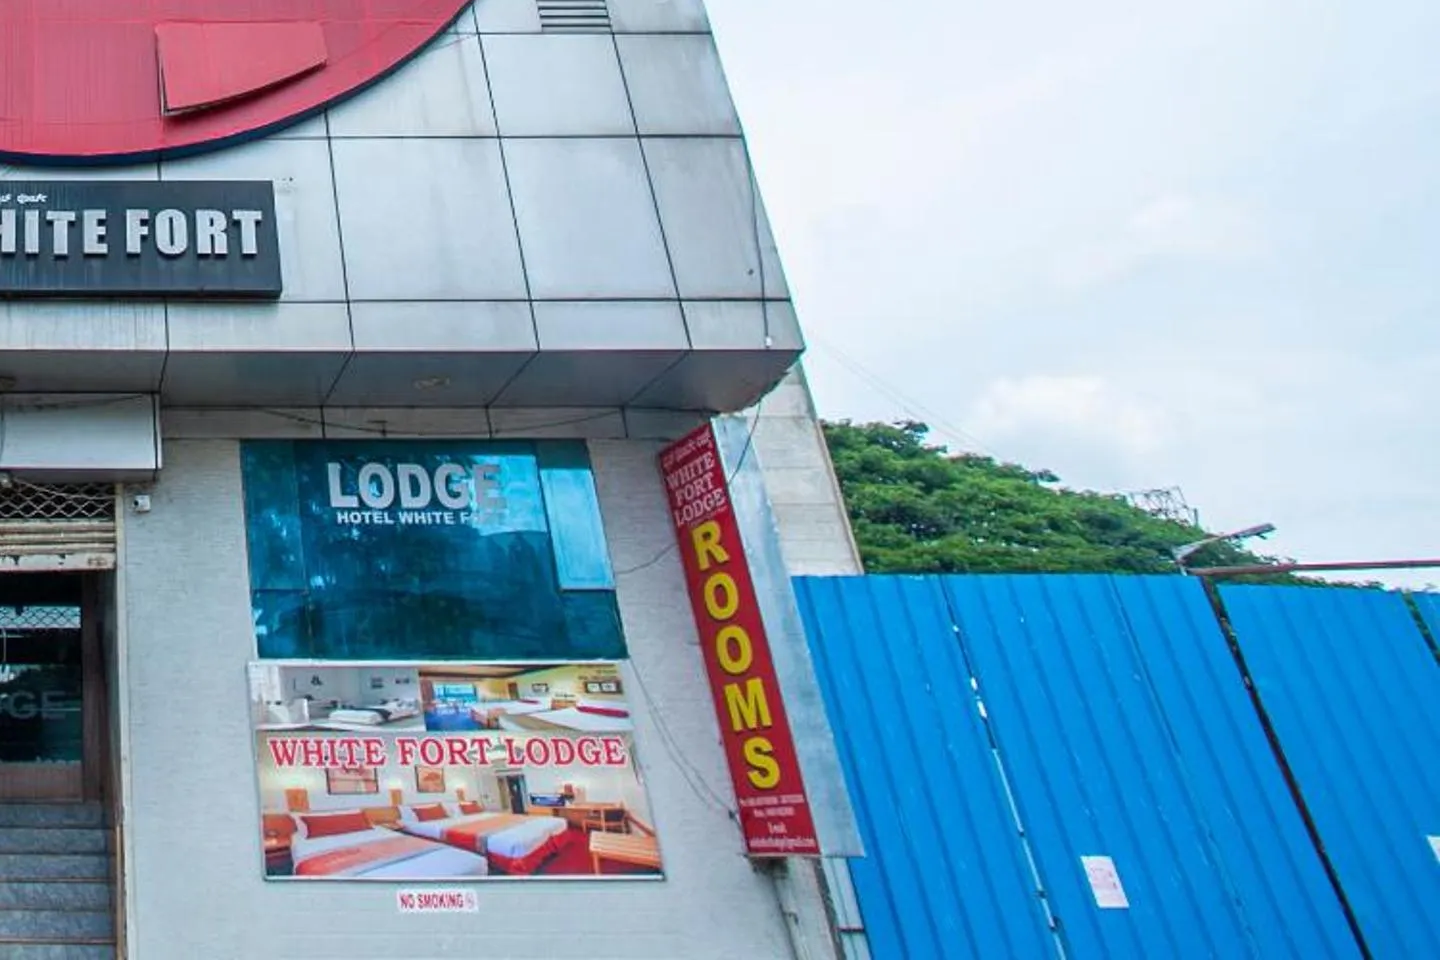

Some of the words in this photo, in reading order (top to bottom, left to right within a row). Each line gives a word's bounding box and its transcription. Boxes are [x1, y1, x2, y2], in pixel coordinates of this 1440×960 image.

[125, 209, 263, 254] FORT
[327, 462, 507, 510] LODGE
[665, 451, 715, 491] WHITE
[675, 471, 714, 507] FORT
[336, 511, 394, 525] HOTEL
[398, 511, 455, 525] WHITE
[674, 487, 725, 529] LODGE
[690, 519, 782, 791] ROOMS
[268, 738, 386, 767] WHITE
[398, 738, 493, 767] FORT
[505, 738, 627, 767] LODGE
[400, 893, 415, 908] NO
[418, 892, 464, 908] SMOKING
